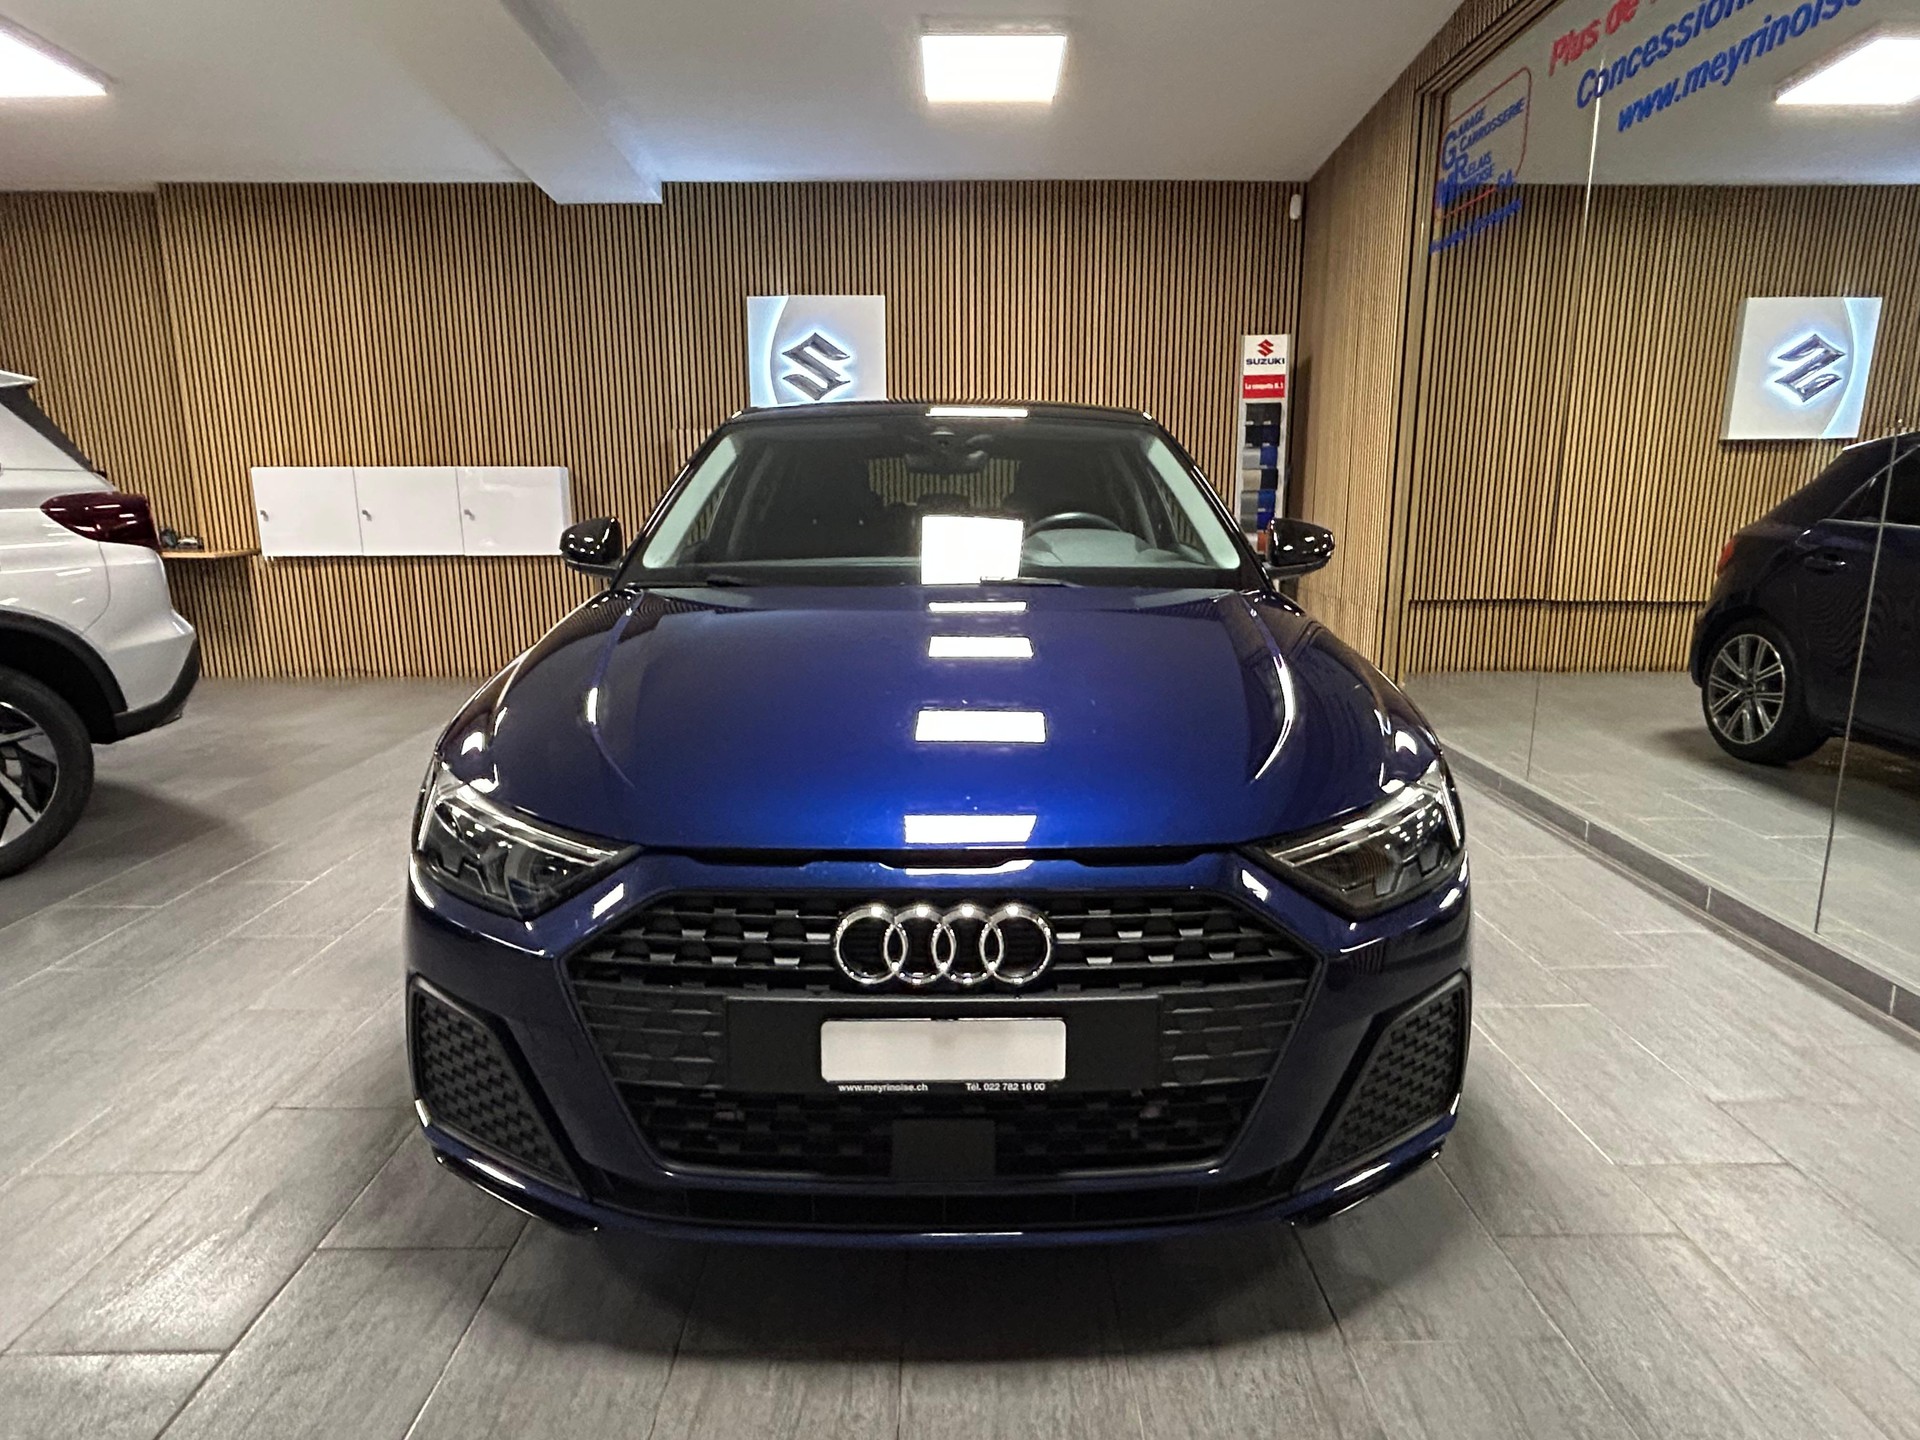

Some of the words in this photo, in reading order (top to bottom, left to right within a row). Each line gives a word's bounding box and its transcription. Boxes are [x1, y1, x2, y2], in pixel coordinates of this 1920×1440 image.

[1549, 19, 1601, 77] Plus
[1618, 0, 1862, 132] www.meyrinois
[838, 1083, 928, 1092] www.meyrinoise.ch
[983, 1082, 1000, 1091] 022
[1002, 1082, 1019, 1091] 782
[1021, 1082, 1032, 1091] 16
[1034, 1082, 1046, 1091] 00
